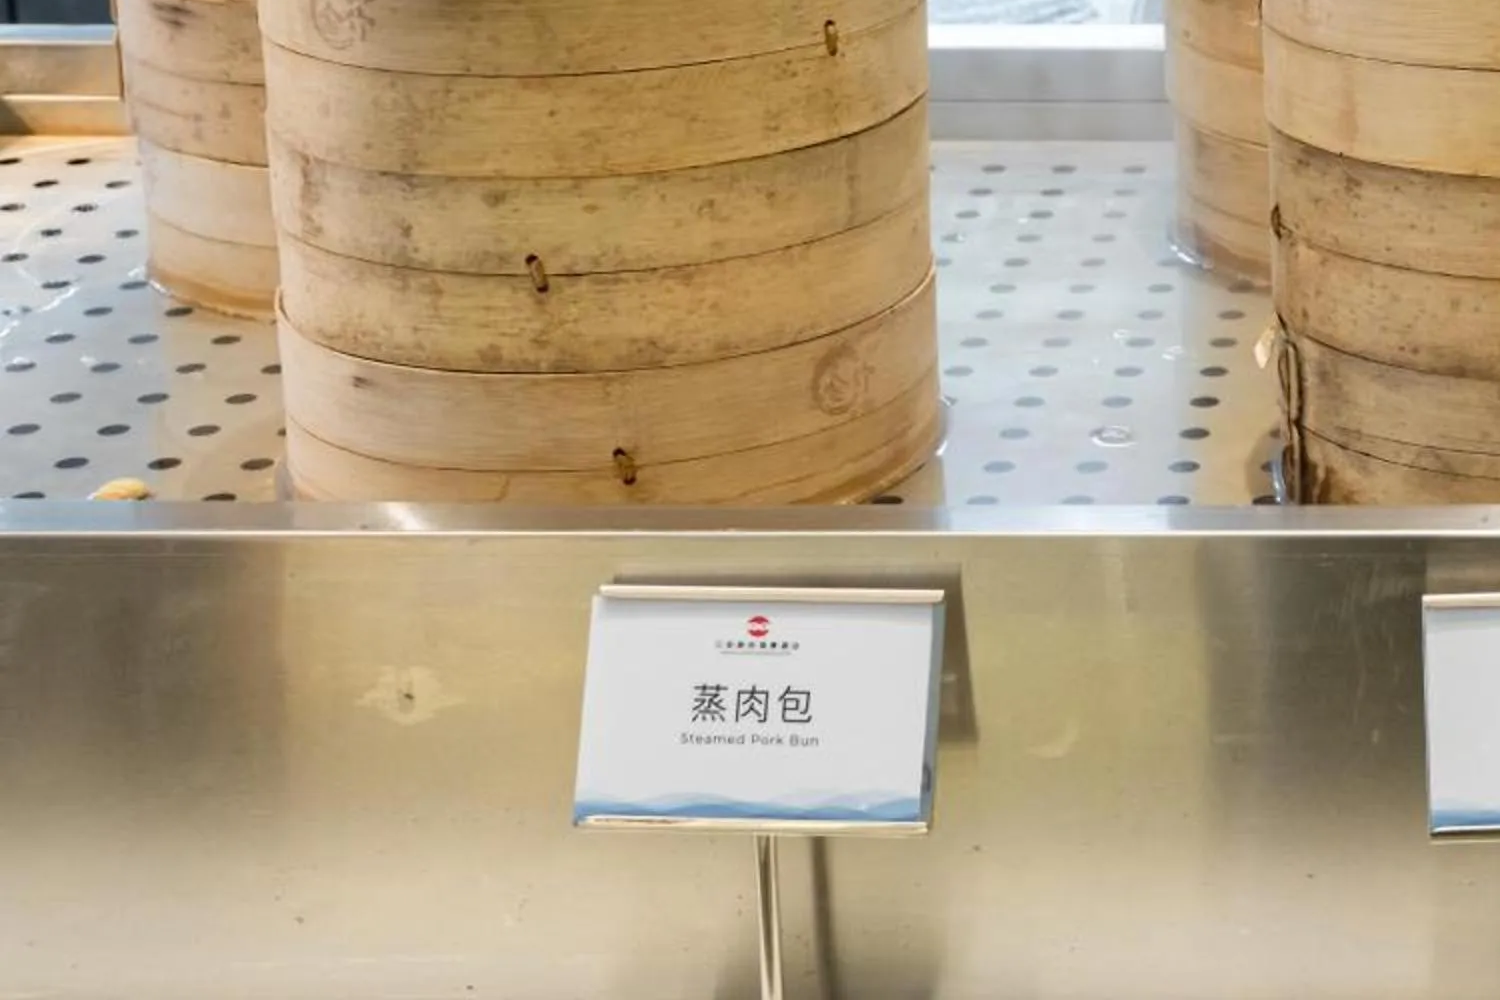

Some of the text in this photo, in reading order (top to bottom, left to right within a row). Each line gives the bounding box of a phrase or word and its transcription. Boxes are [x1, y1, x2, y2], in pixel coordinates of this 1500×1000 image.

[691, 684, 813, 723] 蒸肉包
[680, 732, 819, 747] Steamed Pork Bun
